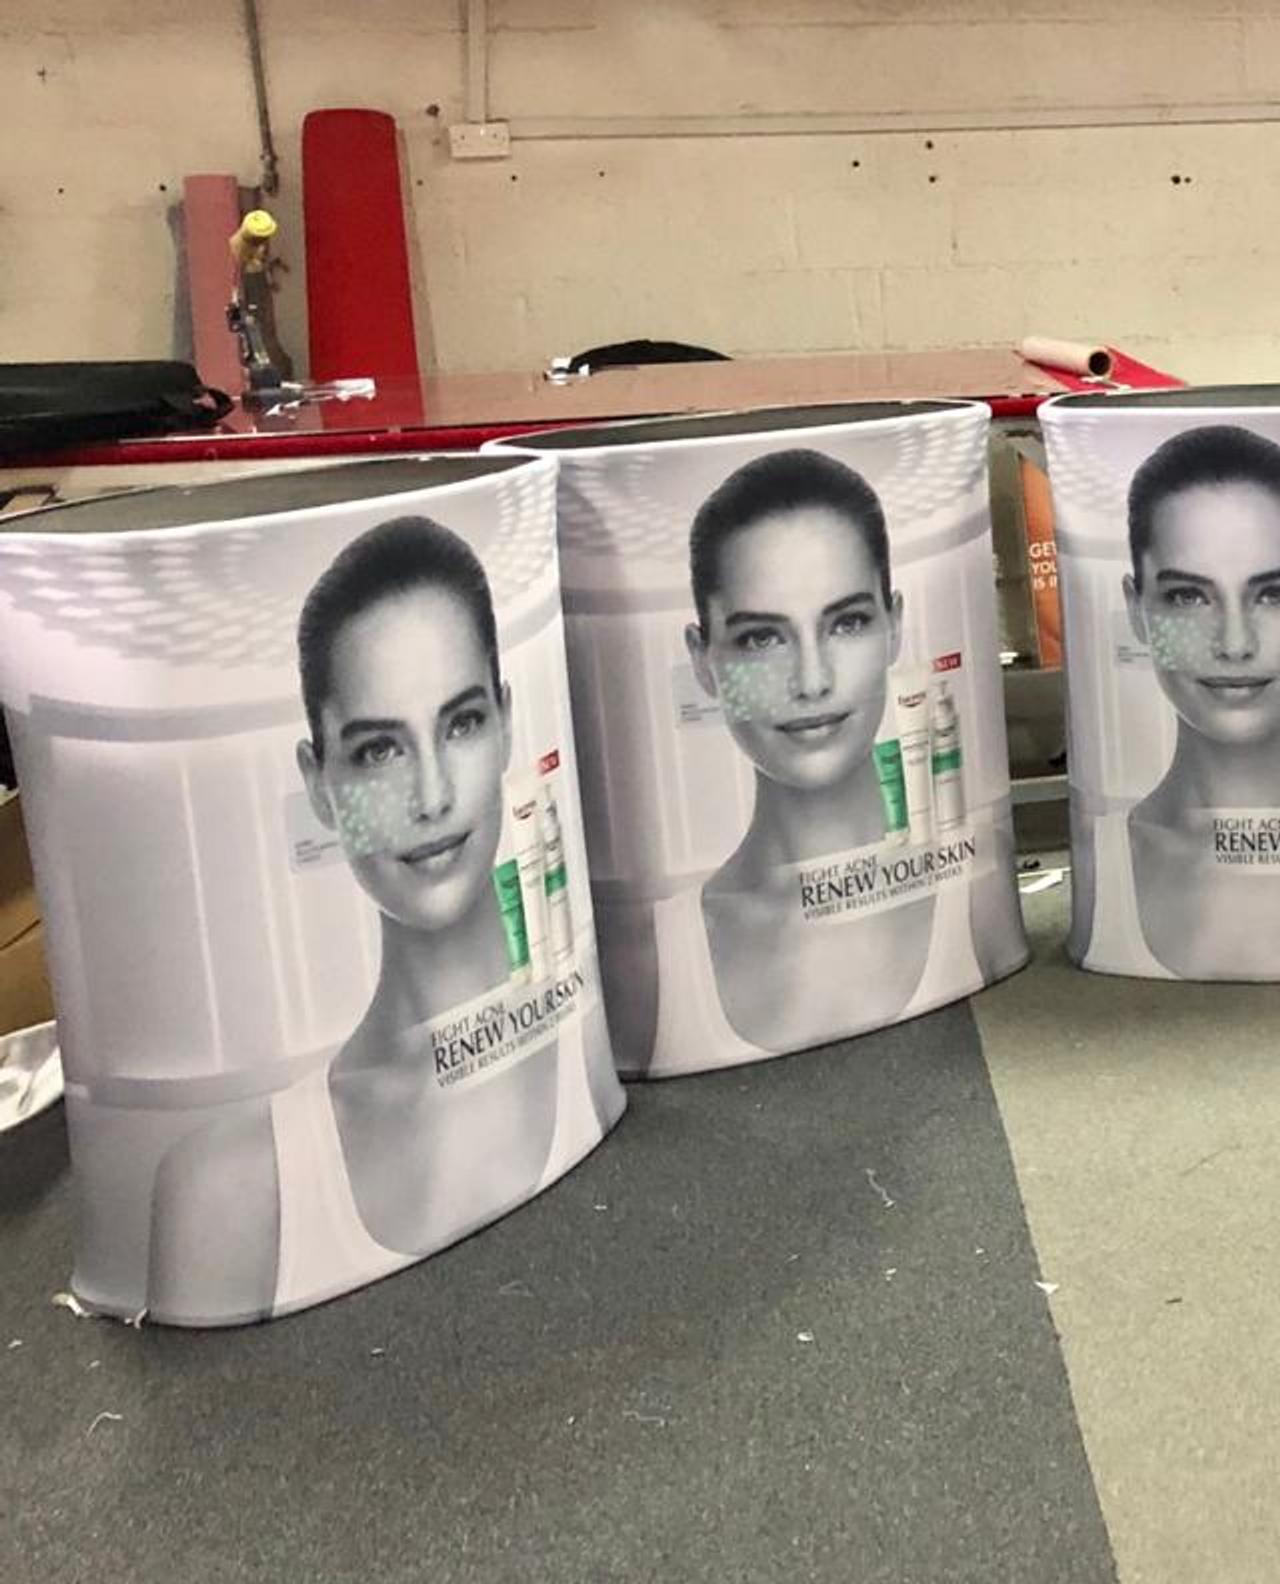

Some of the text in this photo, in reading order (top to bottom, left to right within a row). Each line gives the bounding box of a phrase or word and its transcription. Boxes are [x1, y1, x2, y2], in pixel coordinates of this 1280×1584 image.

[1213, 818, 1252, 831] FIGHT
[799, 854, 877, 885] FIGHT ACNE
[802, 836, 976, 908] RENEW YOUR SKIN
[1216, 853, 1254, 865] VISIBLE
[434, 1015, 506, 1074] RENEW
[509, 989, 556, 1034] YOUR
